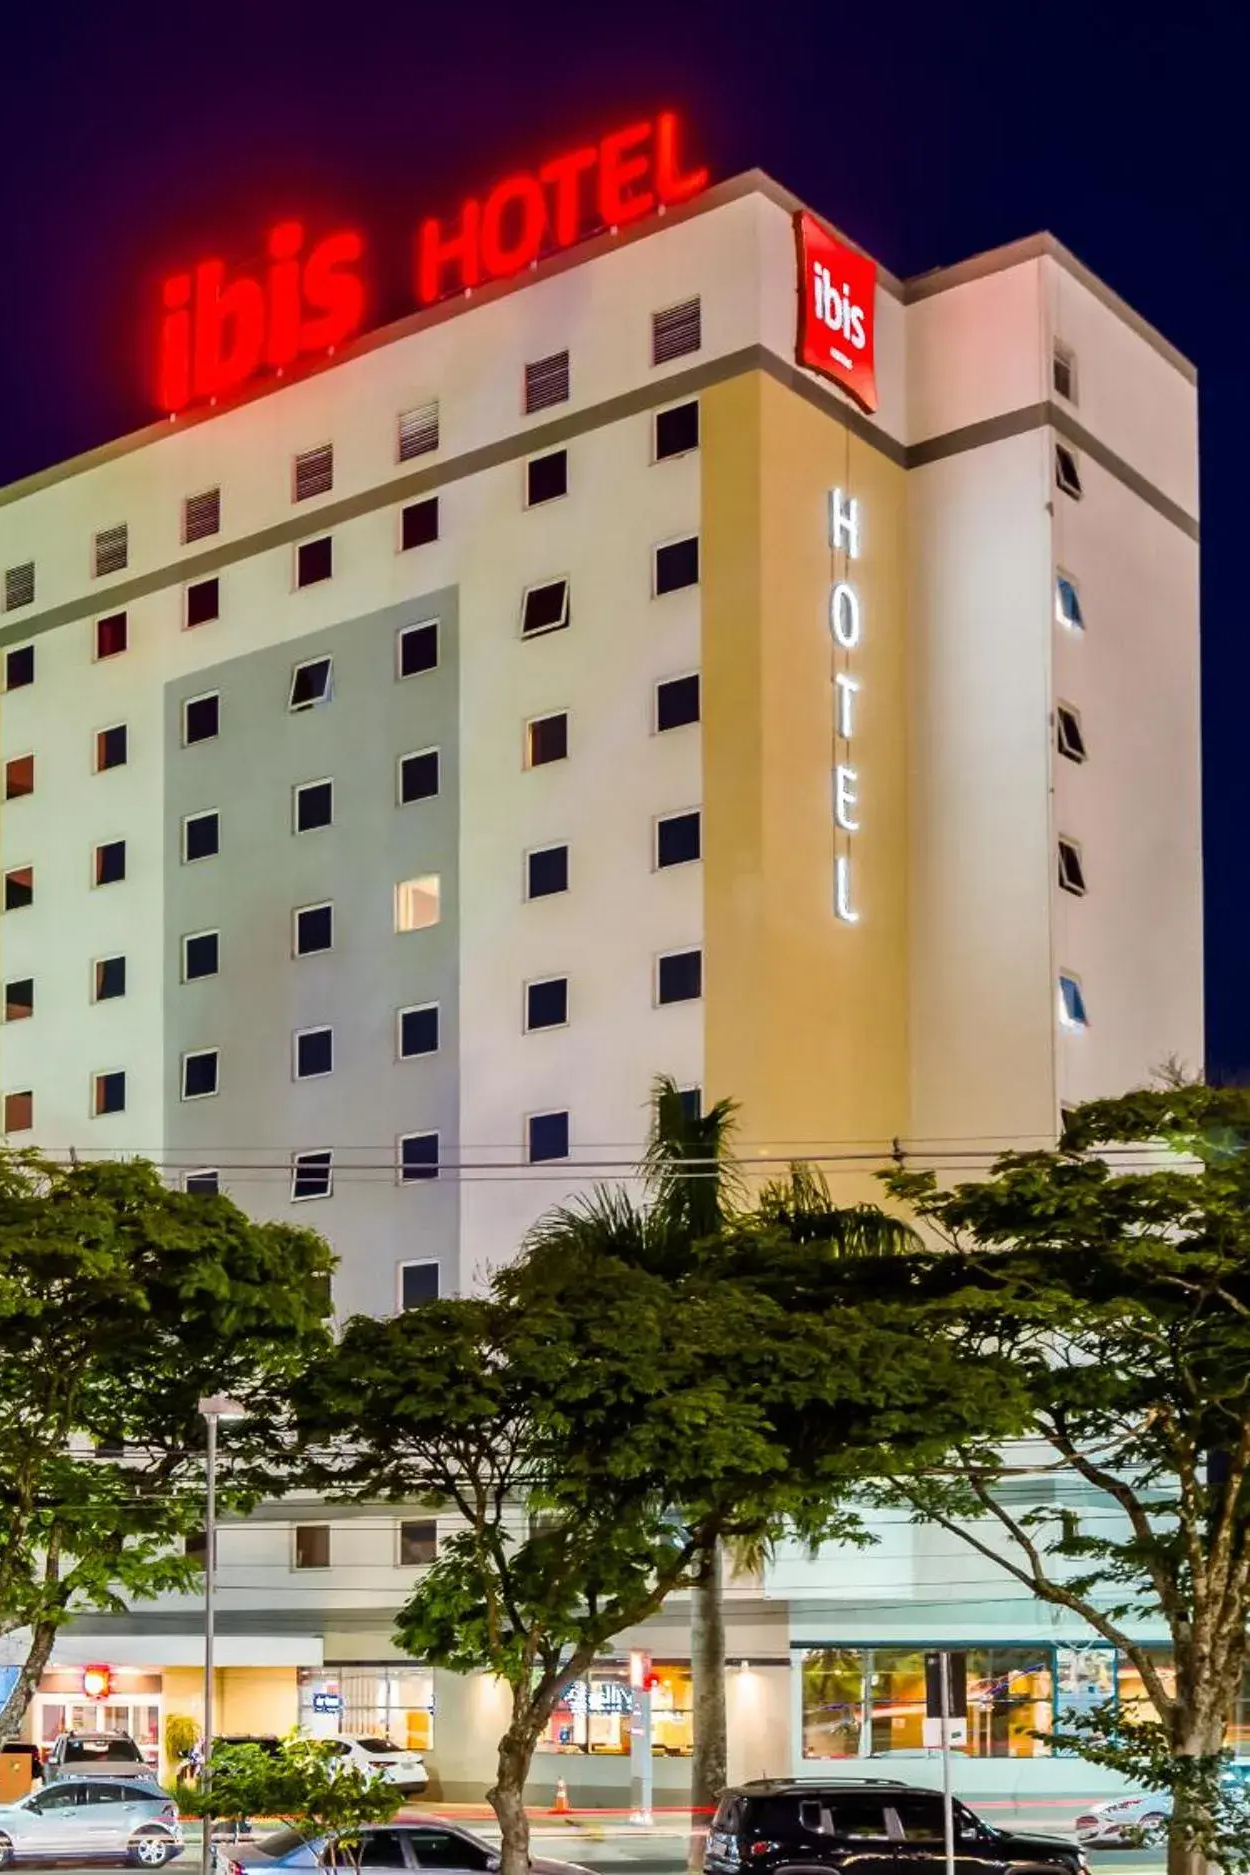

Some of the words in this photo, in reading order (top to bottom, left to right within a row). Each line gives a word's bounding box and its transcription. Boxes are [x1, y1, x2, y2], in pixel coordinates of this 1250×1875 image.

[158, 221, 364, 411] ibis
[419, 111, 708, 301] HOTEL
[813, 260, 866, 350] ibis
[828, 486, 859, 925] HOTEL
